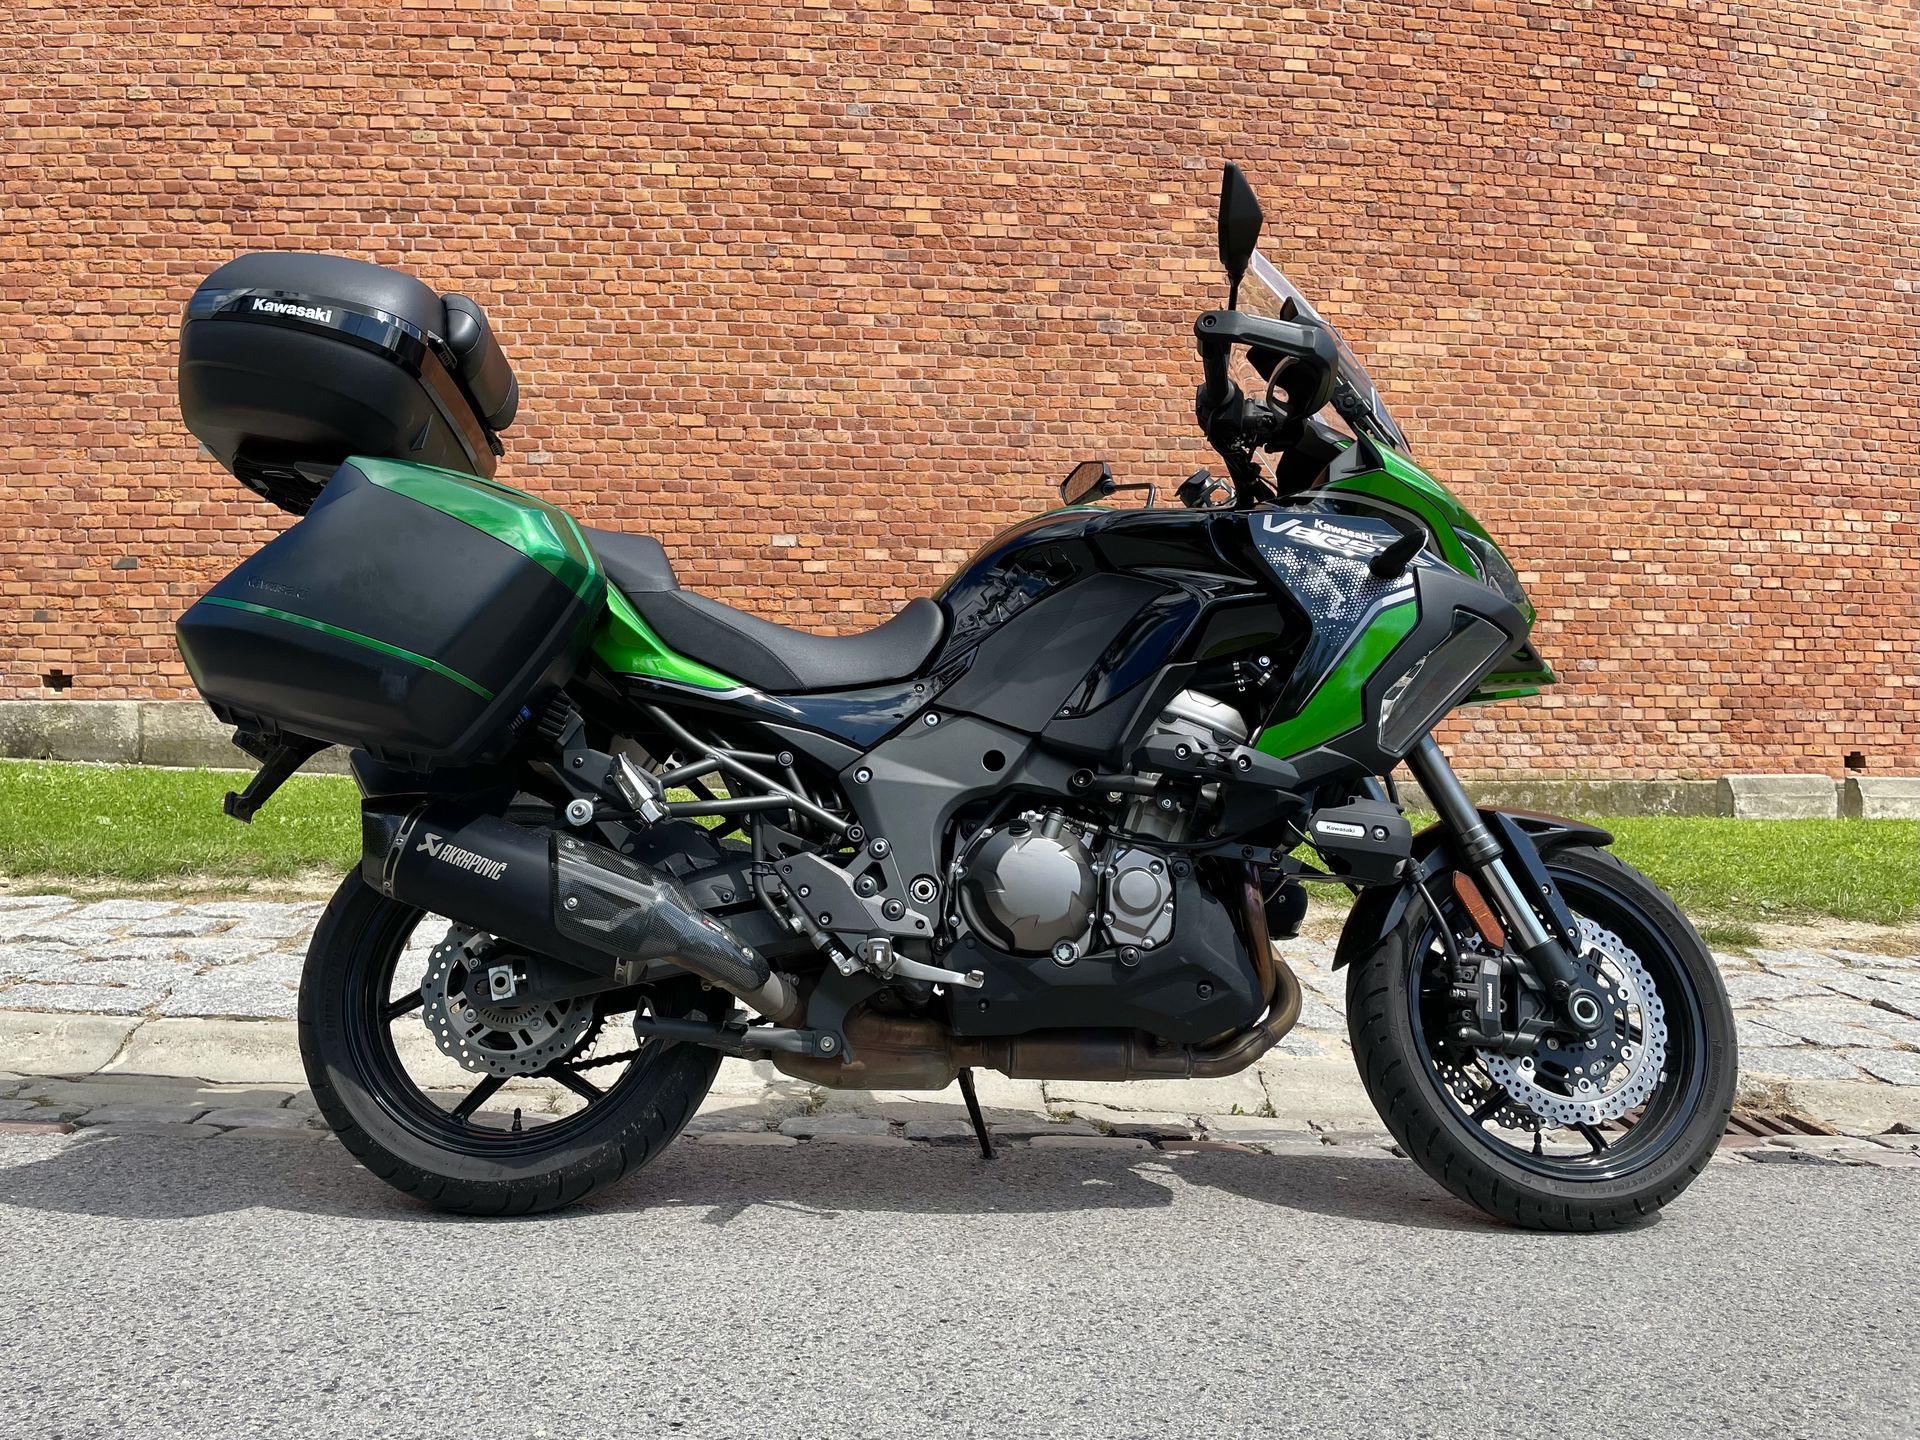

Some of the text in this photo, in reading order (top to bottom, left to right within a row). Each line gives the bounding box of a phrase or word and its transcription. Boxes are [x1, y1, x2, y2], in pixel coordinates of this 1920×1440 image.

[252, 298, 332, 323] Kawasaki
[1313, 518, 1374, 543] Kawasaki
[1326, 824, 1356, 833] Kawasaki
[437, 843, 508, 881] AKRAPOVIČ
